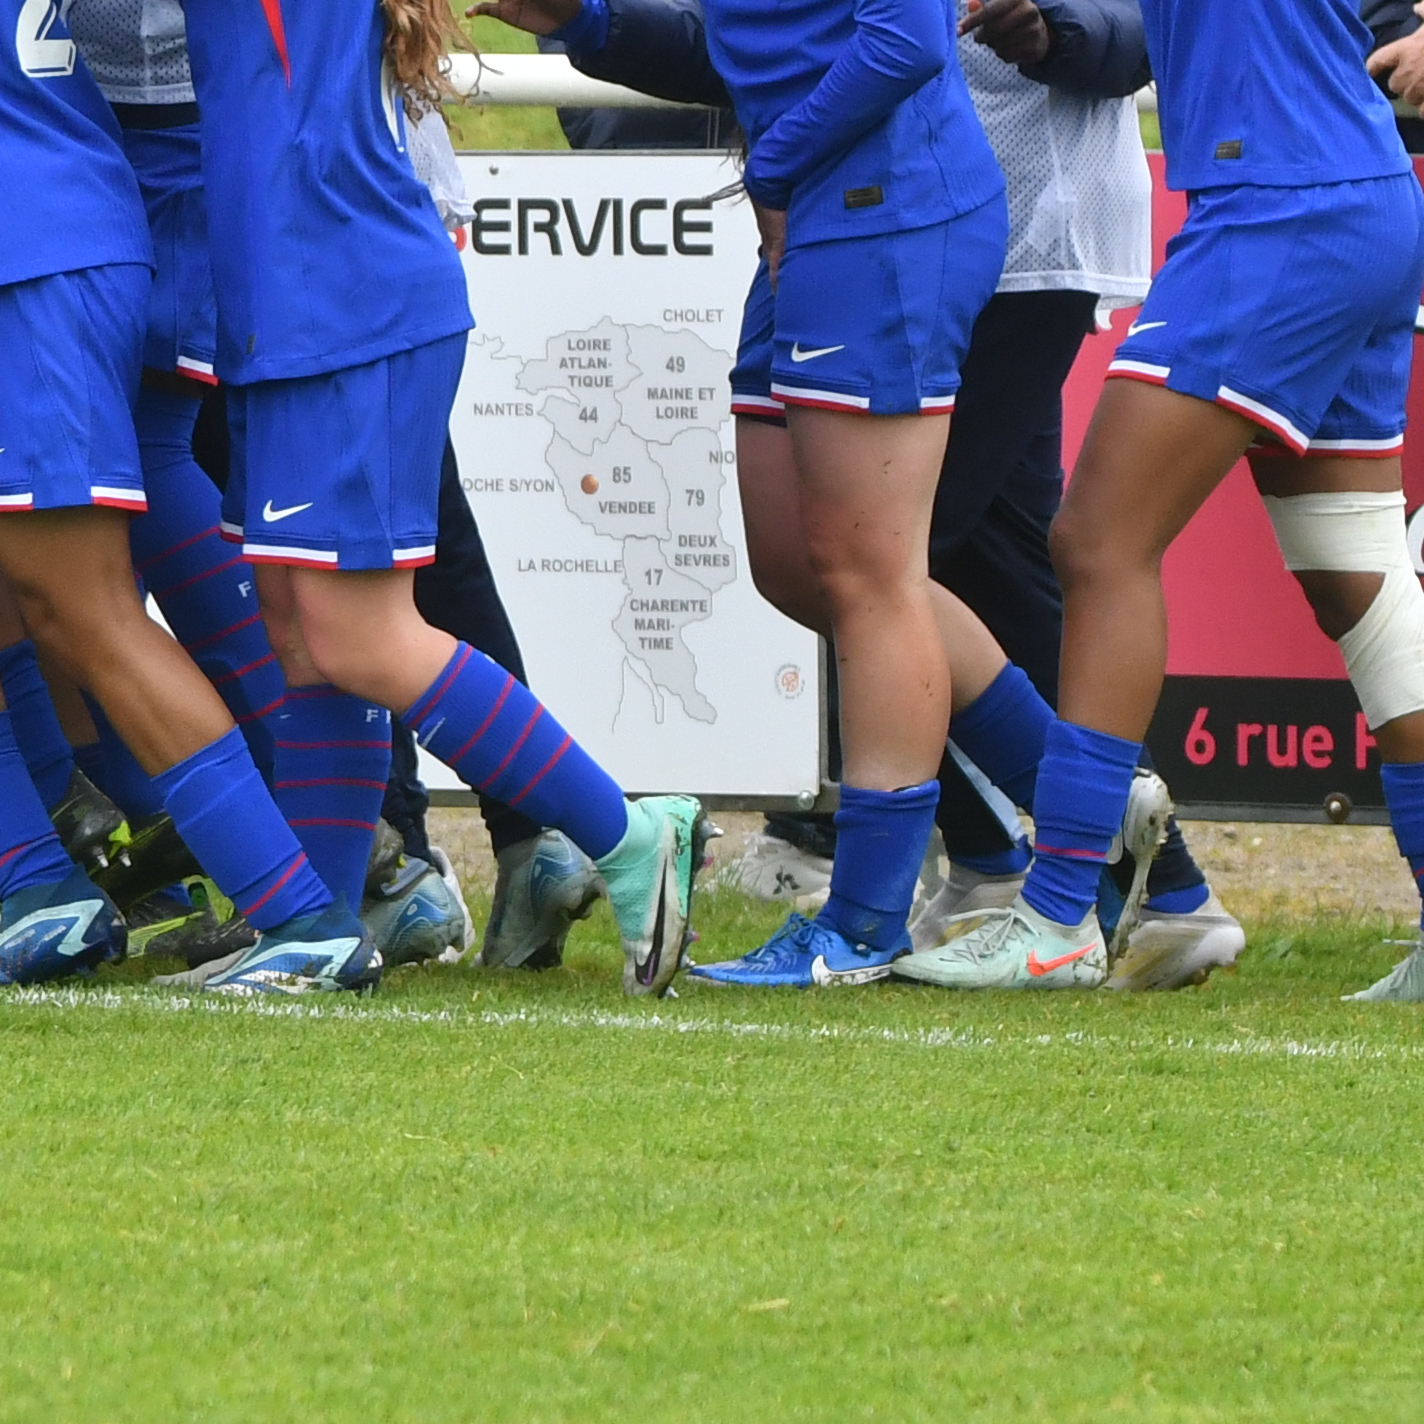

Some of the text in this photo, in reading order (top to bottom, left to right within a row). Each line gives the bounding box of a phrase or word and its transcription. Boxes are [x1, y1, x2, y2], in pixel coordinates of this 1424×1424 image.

[450, 197, 714, 256] ERVICE
[663, 309, 724, 323] CHOLET
[567, 338, 612, 352] LOIRE
[559, 357, 612, 369] ATLAN-
[665, 356, 686, 373] 49
[568, 375, 614, 389] TIQUE
[647, 387, 716, 401] MAINE ET
[473, 403, 534, 417] NANTES
[578, 406, 598, 423] 44
[656, 406, 698, 420] LOIRE
[612, 466, 632, 484] 85
[509, 478, 555, 493] S/YON
[685, 489, 705, 507] 79
[598, 501, 656, 515] VENDEE
[678, 535, 717, 548] DEUX
[517, 559, 623, 574] LA ROCHELLE
[674, 554, 730, 567] SEVRES
[645, 569, 664, 586] 17
[629, 599, 708, 613] CHARENTE
[634, 618, 676, 632] MARI-
[639, 637, 674, 650] TIME
[1185, 707, 1217, 765] 6
[1236, 723, 1334, 769] rue
